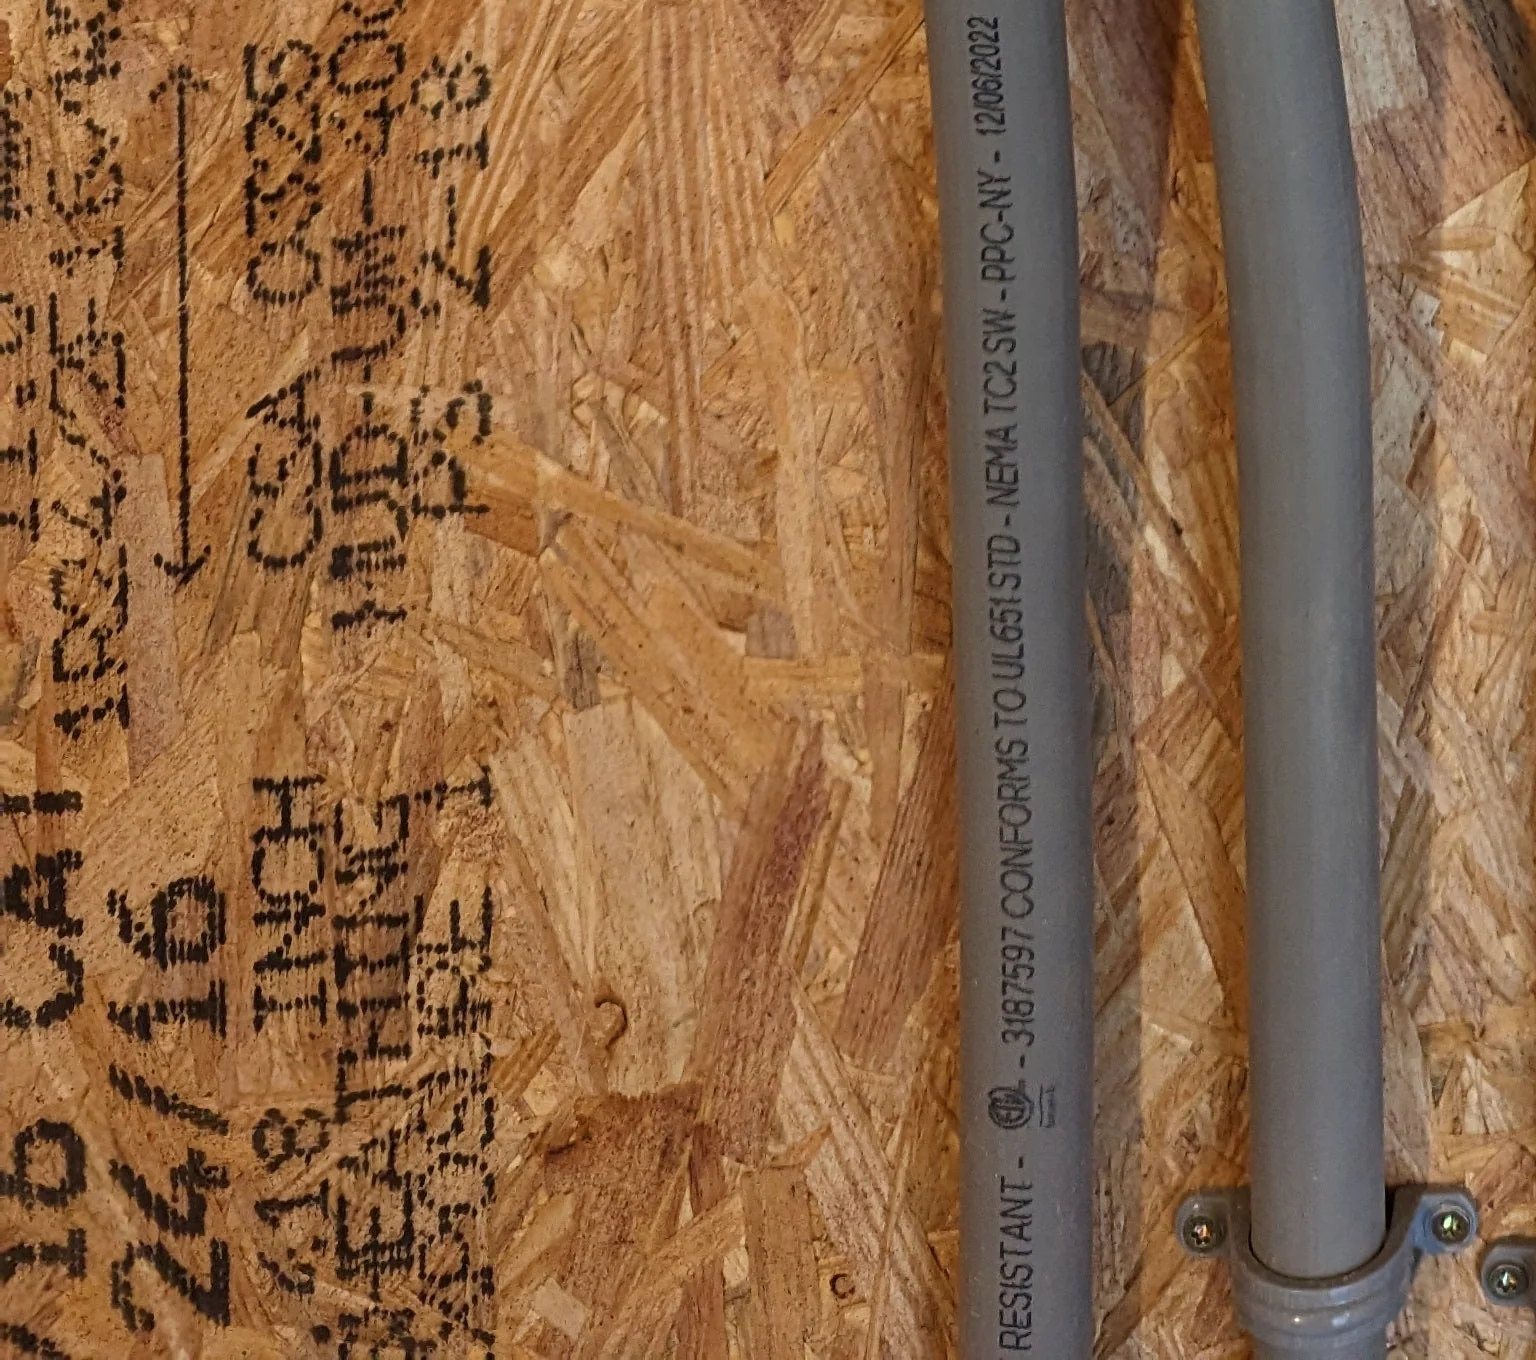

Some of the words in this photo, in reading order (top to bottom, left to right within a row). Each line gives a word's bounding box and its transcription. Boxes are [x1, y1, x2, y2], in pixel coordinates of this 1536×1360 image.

[966, 15, 1009, 138] 12/06/2022
[409, 50, 491, 318] 2-18
[977, 167, 1015, 284] PPC-NY
[982, 307, 1017, 354] SW
[983, 360, 1017, 416] TC2
[247, 367, 323, 568] CSA
[409, 379, 491, 517] PS
[984, 423, 1019, 509] NEMA
[986, 533, 1022, 592] STD
[988, 595, 1027, 683] UL651
[993, 687, 1028, 730] TO
[993, 739, 1034, 919] CONFORMS
[251, 774, 329, 1033] INCH
[1001, 924, 1035, 1048] 3187597
[107, 875, 230, 1333] 24/16
[999, 1176, 1034, 1352] RESISTANT
